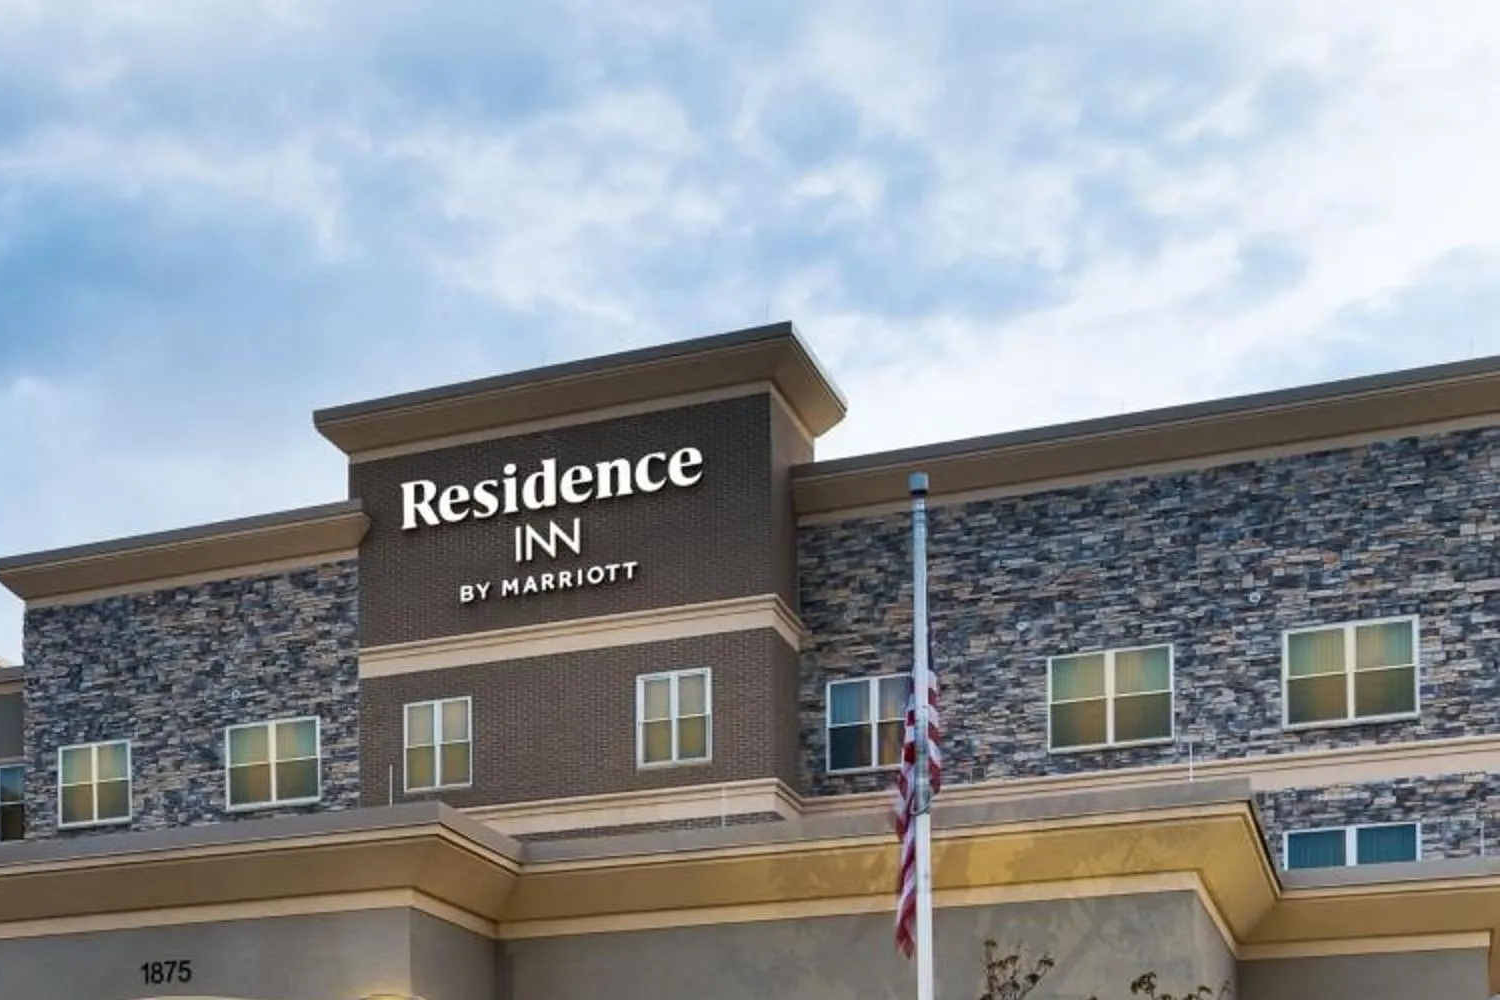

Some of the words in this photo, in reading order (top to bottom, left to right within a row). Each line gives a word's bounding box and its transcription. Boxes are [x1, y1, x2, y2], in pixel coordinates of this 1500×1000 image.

[401, 447, 703, 529] Residence
[515, 517, 581, 562] INN
[460, 582, 490, 603] BY
[502, 561, 639, 597] MARRIOTT
[141, 960, 192, 985] 1875
